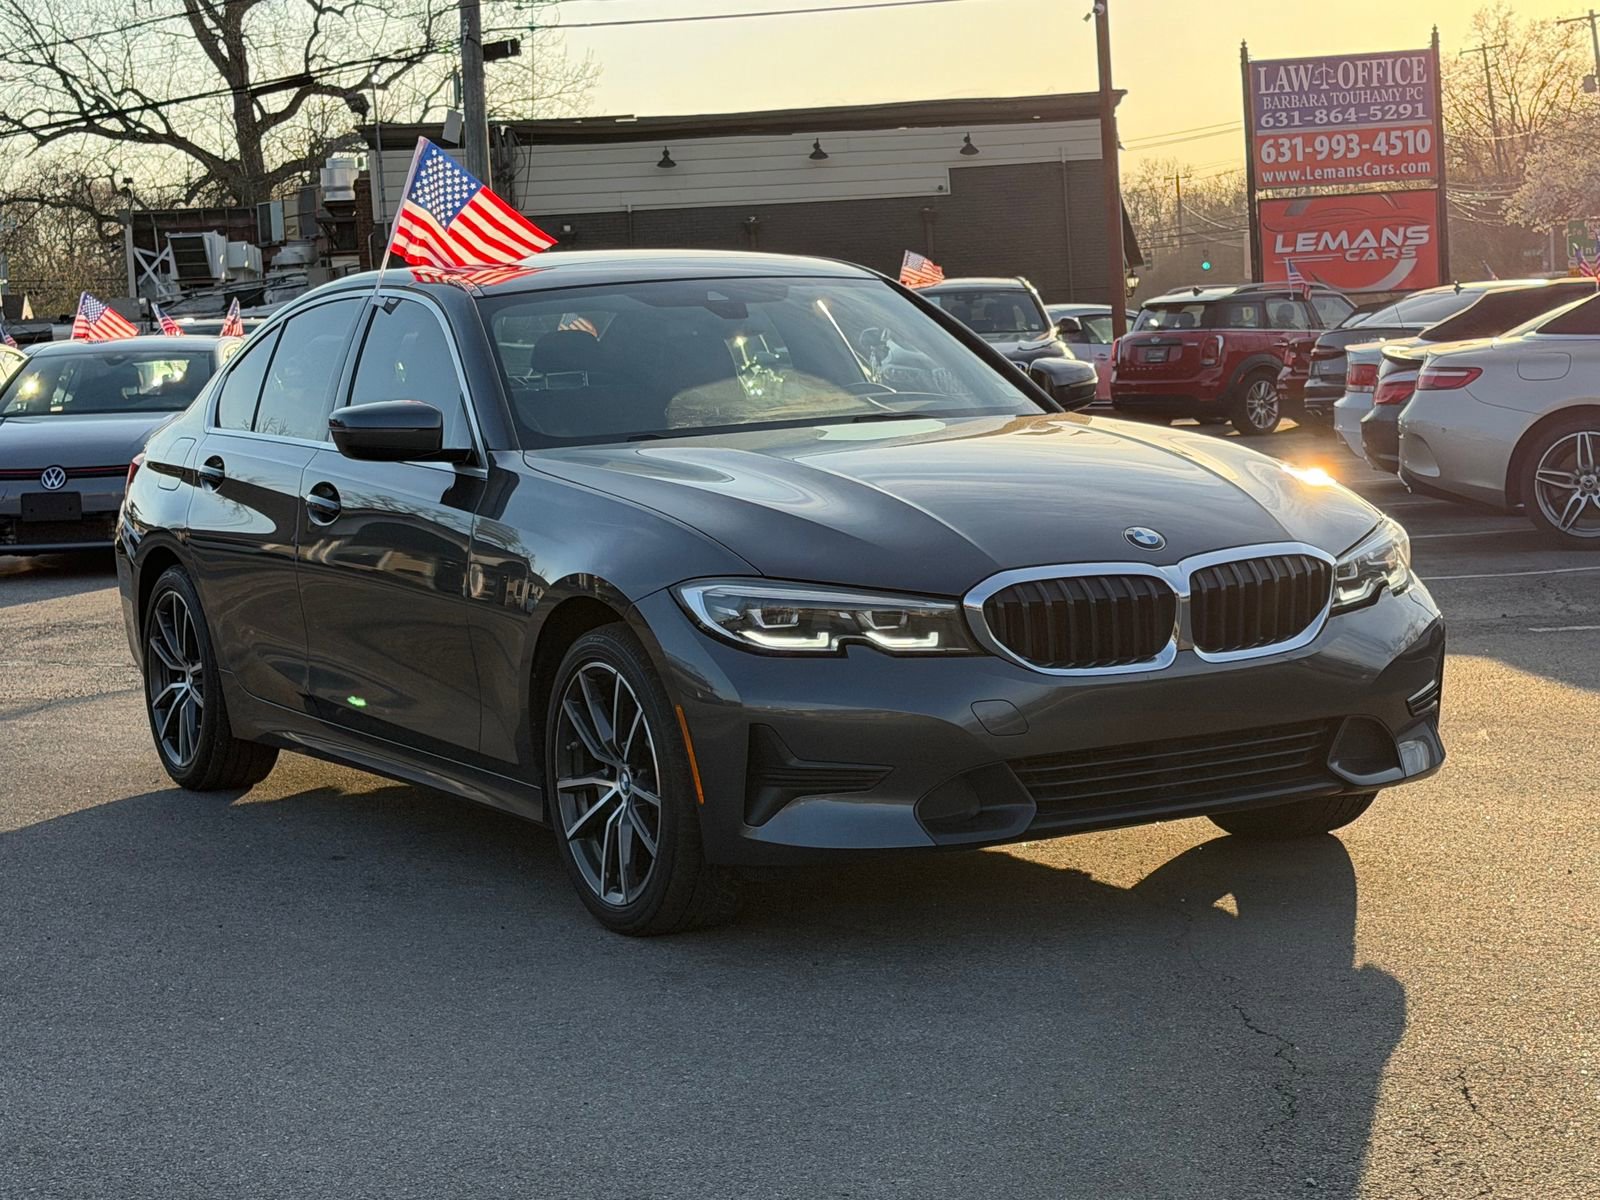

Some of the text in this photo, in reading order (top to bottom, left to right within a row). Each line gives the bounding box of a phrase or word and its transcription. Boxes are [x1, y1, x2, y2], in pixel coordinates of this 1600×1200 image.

[1258, 57, 1427, 95] LAW OFFICE
[1263, 86, 1423, 110] BARBARA TOUHAMY PC
[1260, 103, 1427, 128] 631-864-5291
[1261, 129, 1431, 163] 631-993-4510
[1262, 161, 1431, 183] www.LemansCars.com
[1274, 225, 1430, 254] LEMANS
[1345, 247, 1417, 262] CARS
